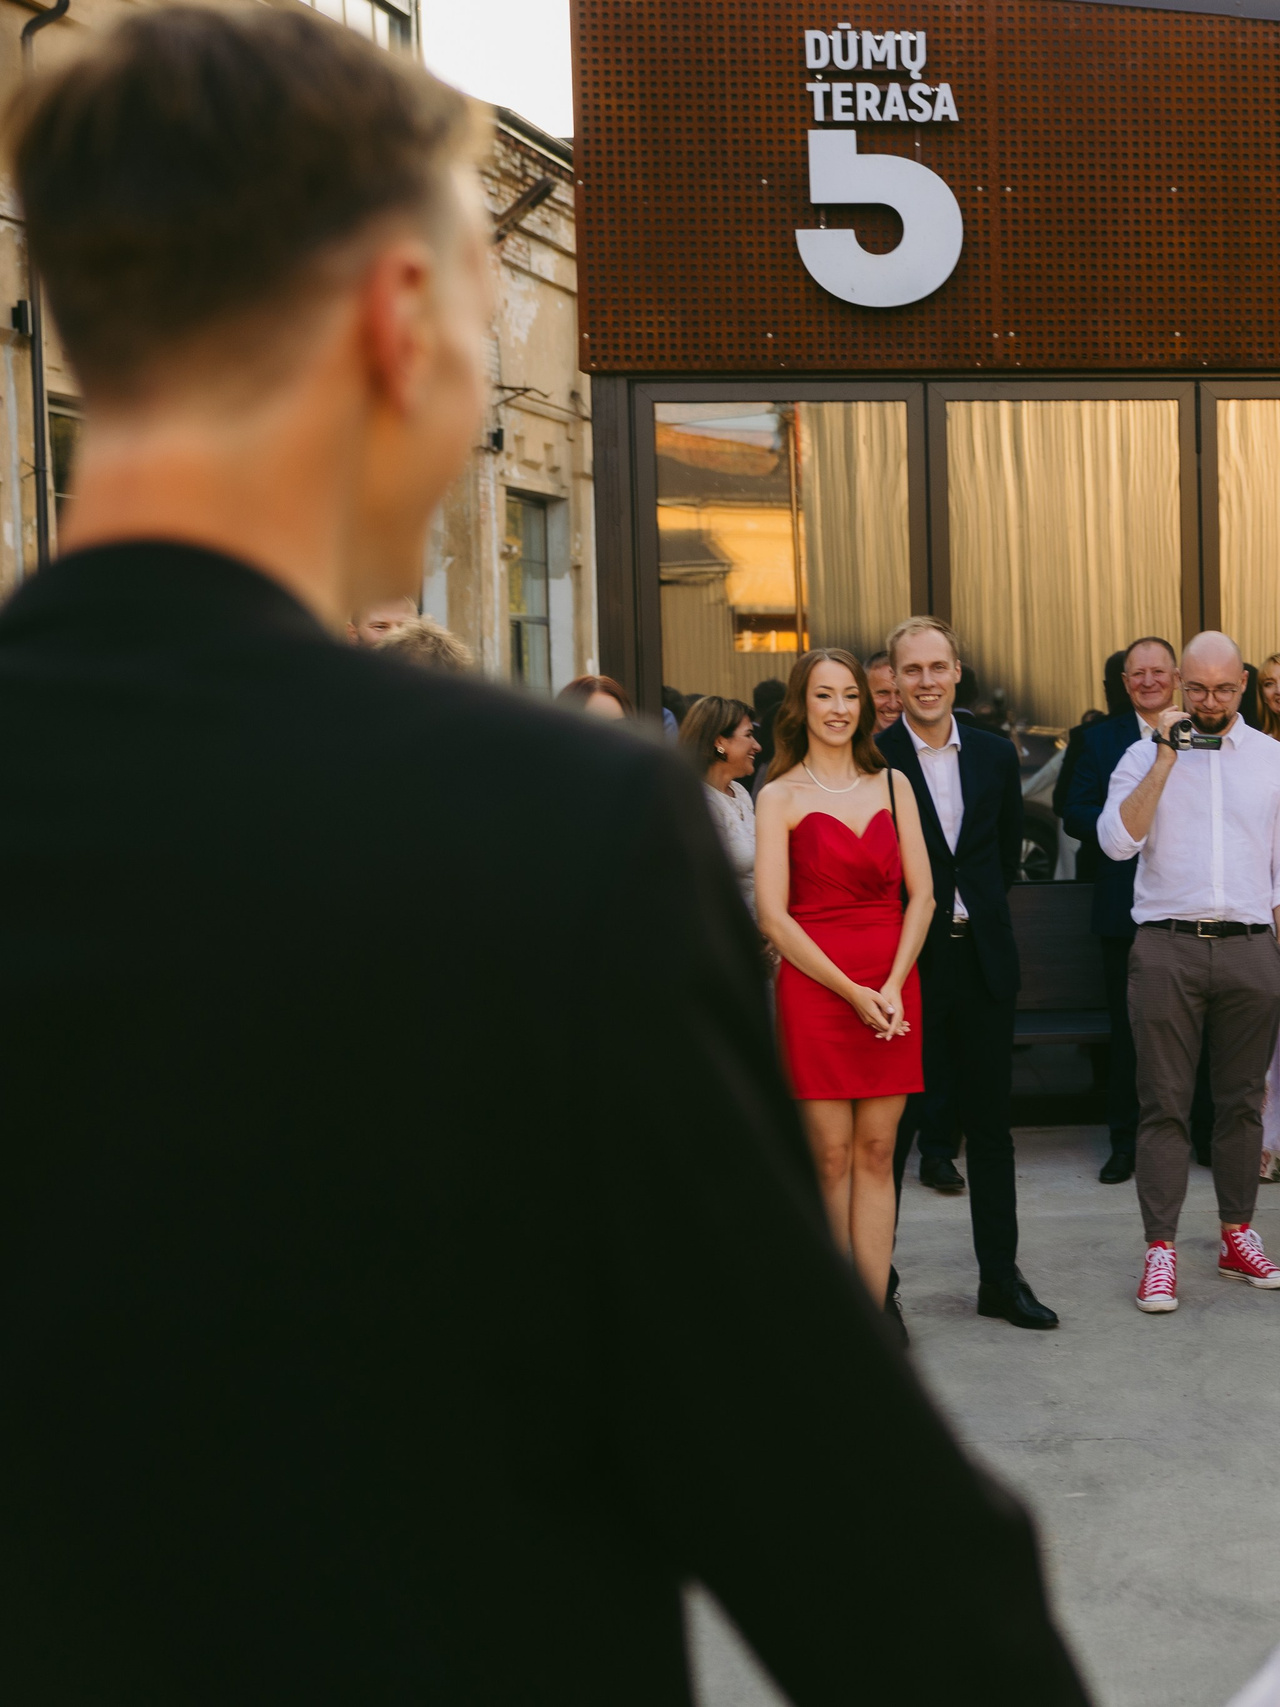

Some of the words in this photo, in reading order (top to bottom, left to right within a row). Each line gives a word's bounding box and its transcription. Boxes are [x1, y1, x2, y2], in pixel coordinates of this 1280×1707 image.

[804, 22, 927, 80] DŪMŲ
[806, 82, 960, 122] TERASA
[795, 129, 964, 308] 5
